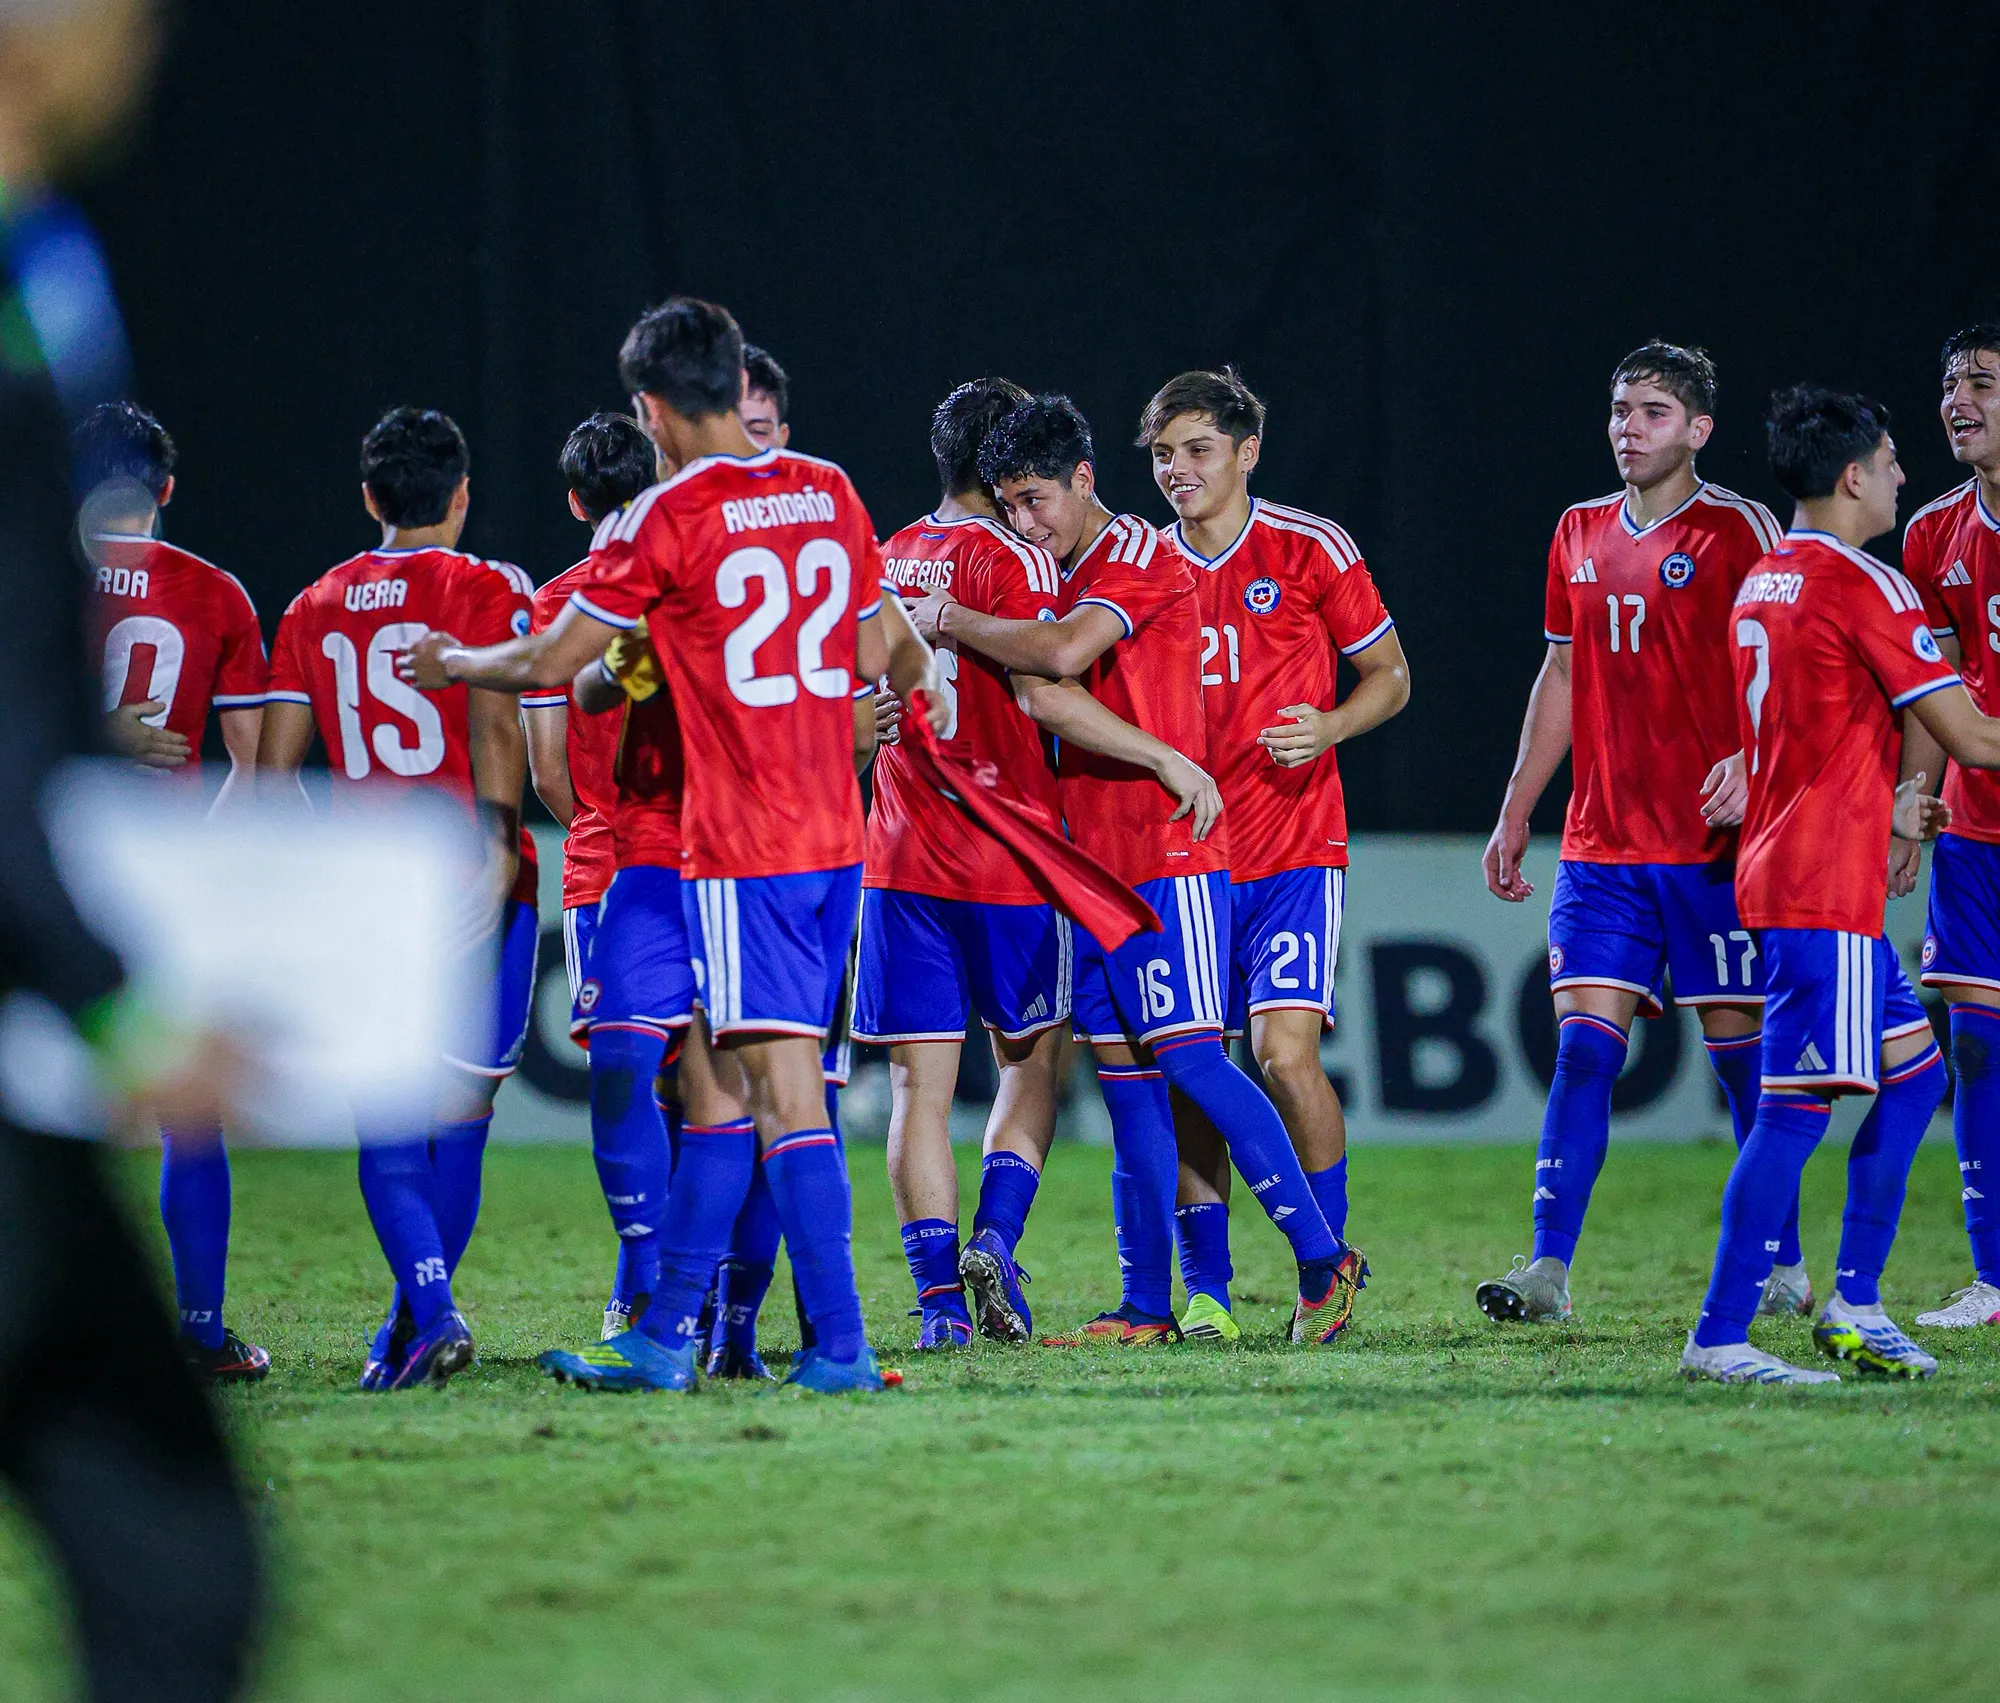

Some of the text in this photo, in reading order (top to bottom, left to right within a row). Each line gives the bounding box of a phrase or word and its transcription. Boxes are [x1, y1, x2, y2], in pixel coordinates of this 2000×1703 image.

[714, 538, 853, 708] 22
[1605, 593, 1646, 653] 17
[1201, 623, 1240, 685] 21
[321, 621, 446, 780] 15
[1269, 931, 1318, 991] 21
[1709, 930, 1757, 987] 17
[1136, 958, 1175, 1024] 16
[1250, 1173, 1282, 1195] CHILE
